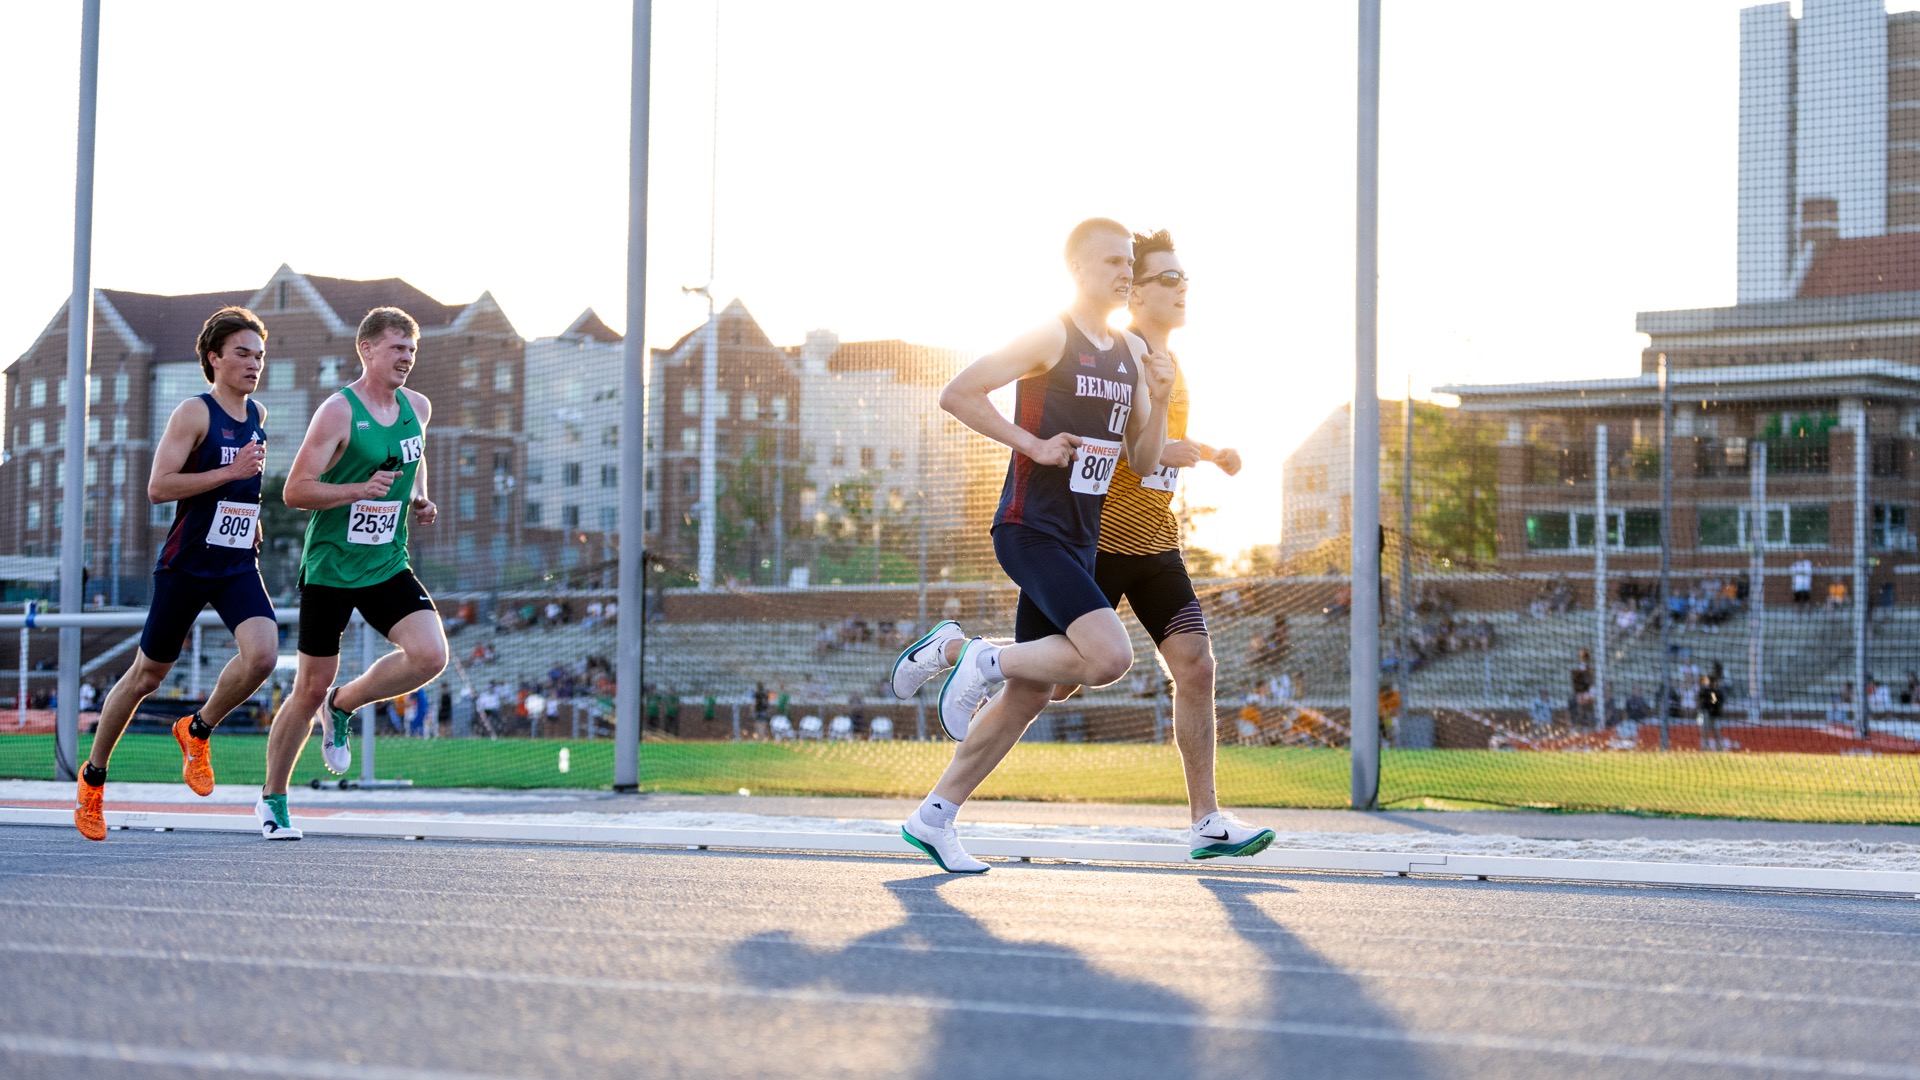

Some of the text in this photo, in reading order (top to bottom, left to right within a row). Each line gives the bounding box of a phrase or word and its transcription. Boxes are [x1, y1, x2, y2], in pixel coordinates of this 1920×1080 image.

[1075, 374, 1132, 406] BELMONT
[1112, 405, 1130, 434] 11
[403, 437, 422, 461] 13
[1081, 455, 1114, 482] 808
[220, 506, 256, 517] TENNESSEE
[355, 504, 398, 514] TENNESSEE
[219, 515, 250, 538] 809
[351, 512, 396, 534] 2534
